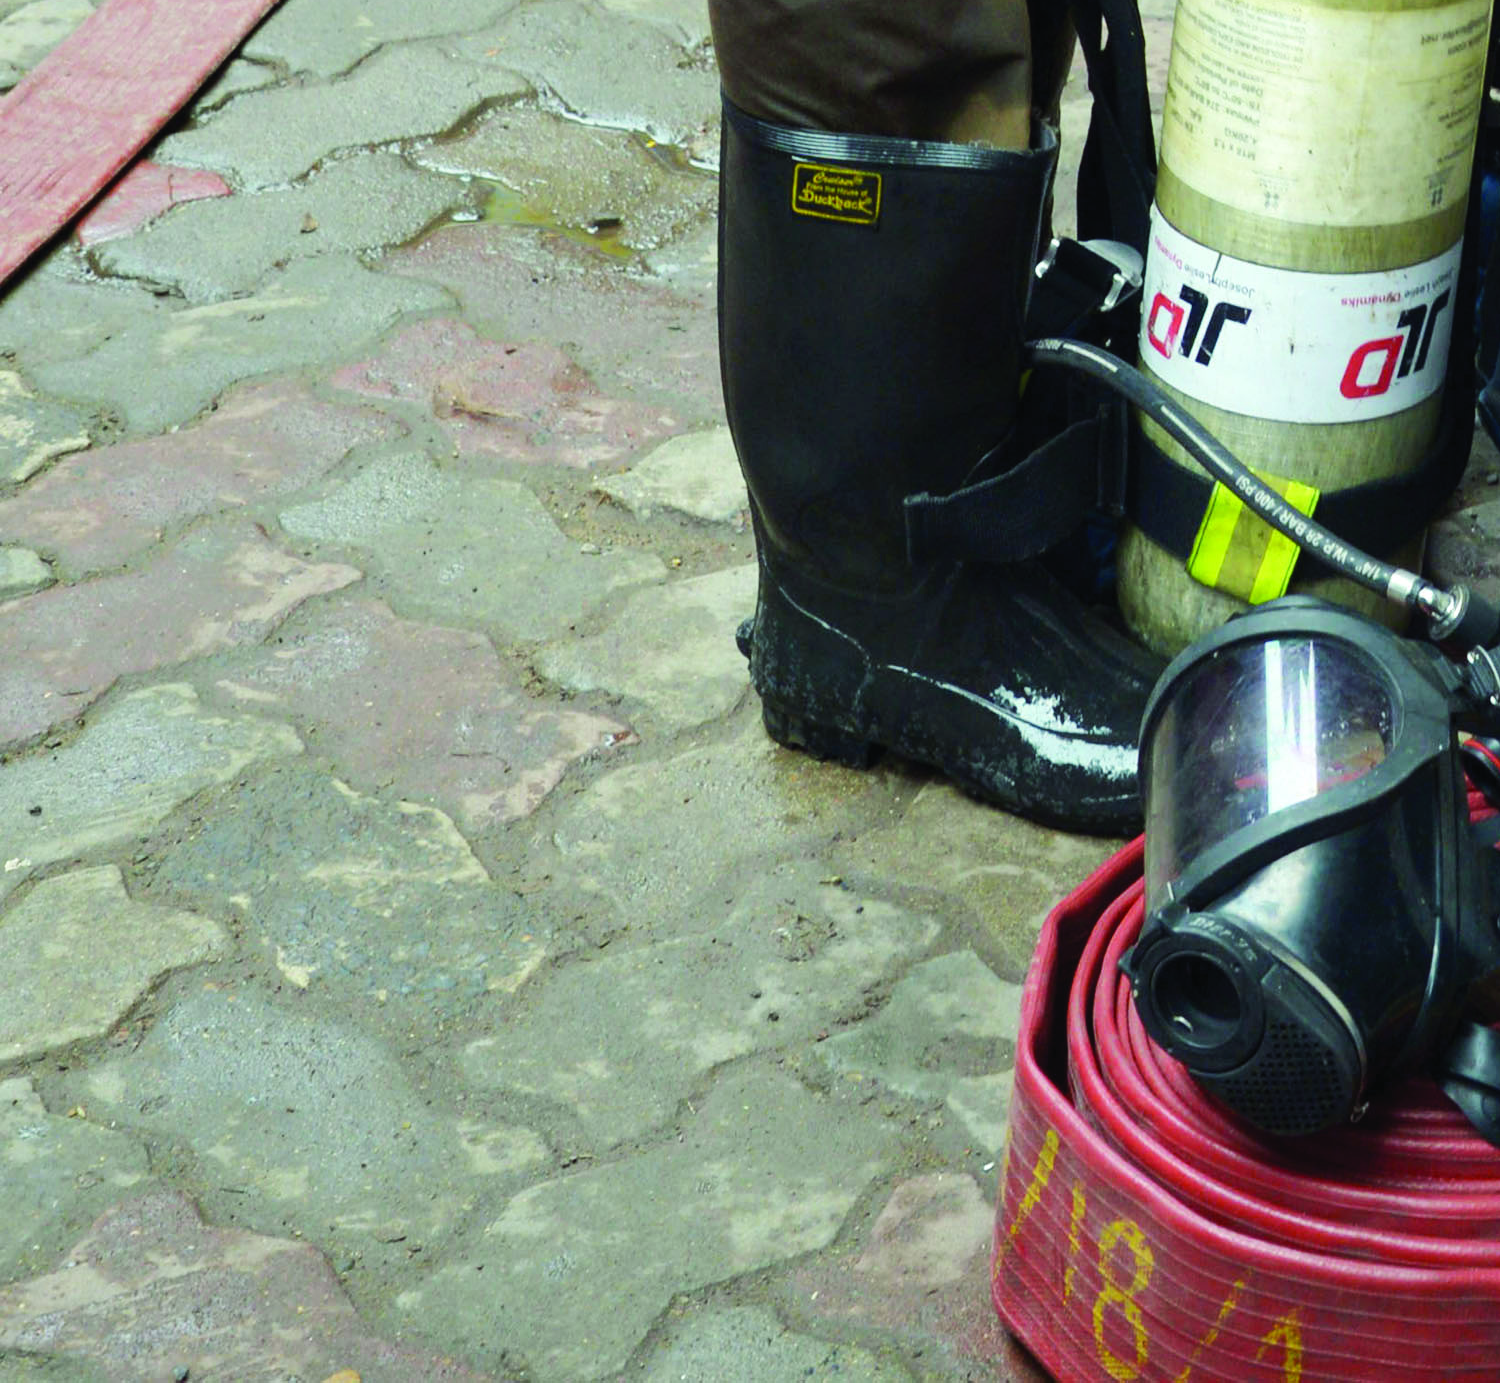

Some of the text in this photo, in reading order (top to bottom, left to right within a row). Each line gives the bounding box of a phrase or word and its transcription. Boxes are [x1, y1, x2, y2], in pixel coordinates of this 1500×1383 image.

[798, 188, 873, 215] Duckback
[1146, 283, 1253, 367] JLD
[1339, 287, 1452, 400] JLD
[1235, 474, 1258, 497] PSI
[1254, 489, 1277, 511] 400
[1279, 511, 1308, 537] BAR
